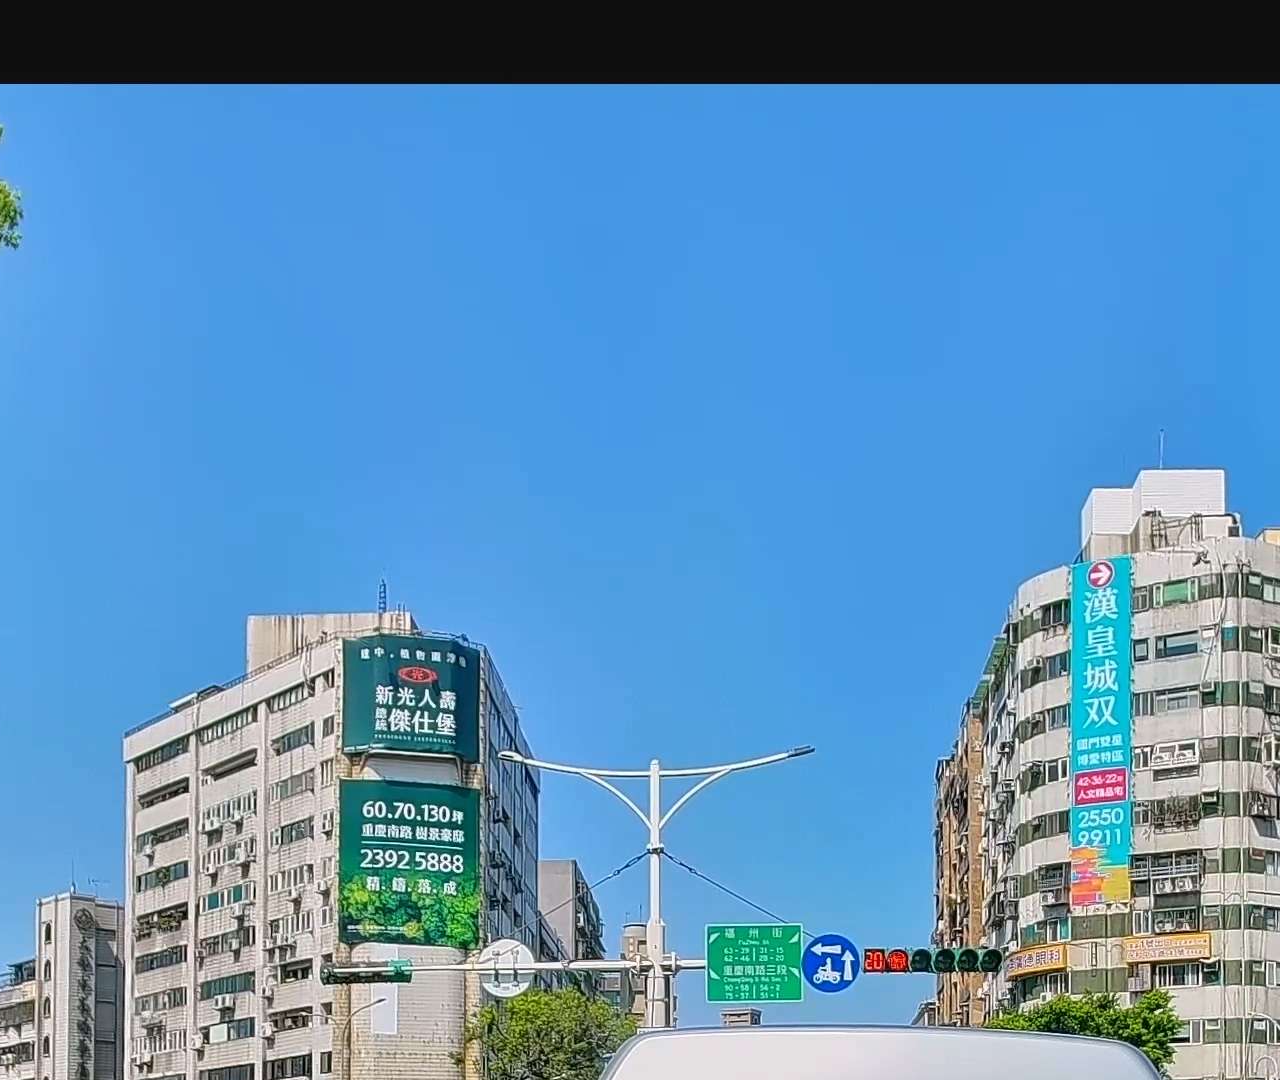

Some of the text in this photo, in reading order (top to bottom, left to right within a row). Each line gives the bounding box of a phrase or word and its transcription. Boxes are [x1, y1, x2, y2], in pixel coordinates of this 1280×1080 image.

[1083, 588, 1120, 729] 漢皇城双
[375, 685, 457, 710] 新光人壽
[1078, 807, 1124, 828] 2550
[361, 823, 412, 840] 重慶南路
[1078, 828, 1121, 846] 9911
[360, 849, 464, 874] 2392 5888
[725, 927, 783, 938] 福州街
[865, 951, 882, 969] 20
[723, 964, 788, 976] 重慶南路三段
